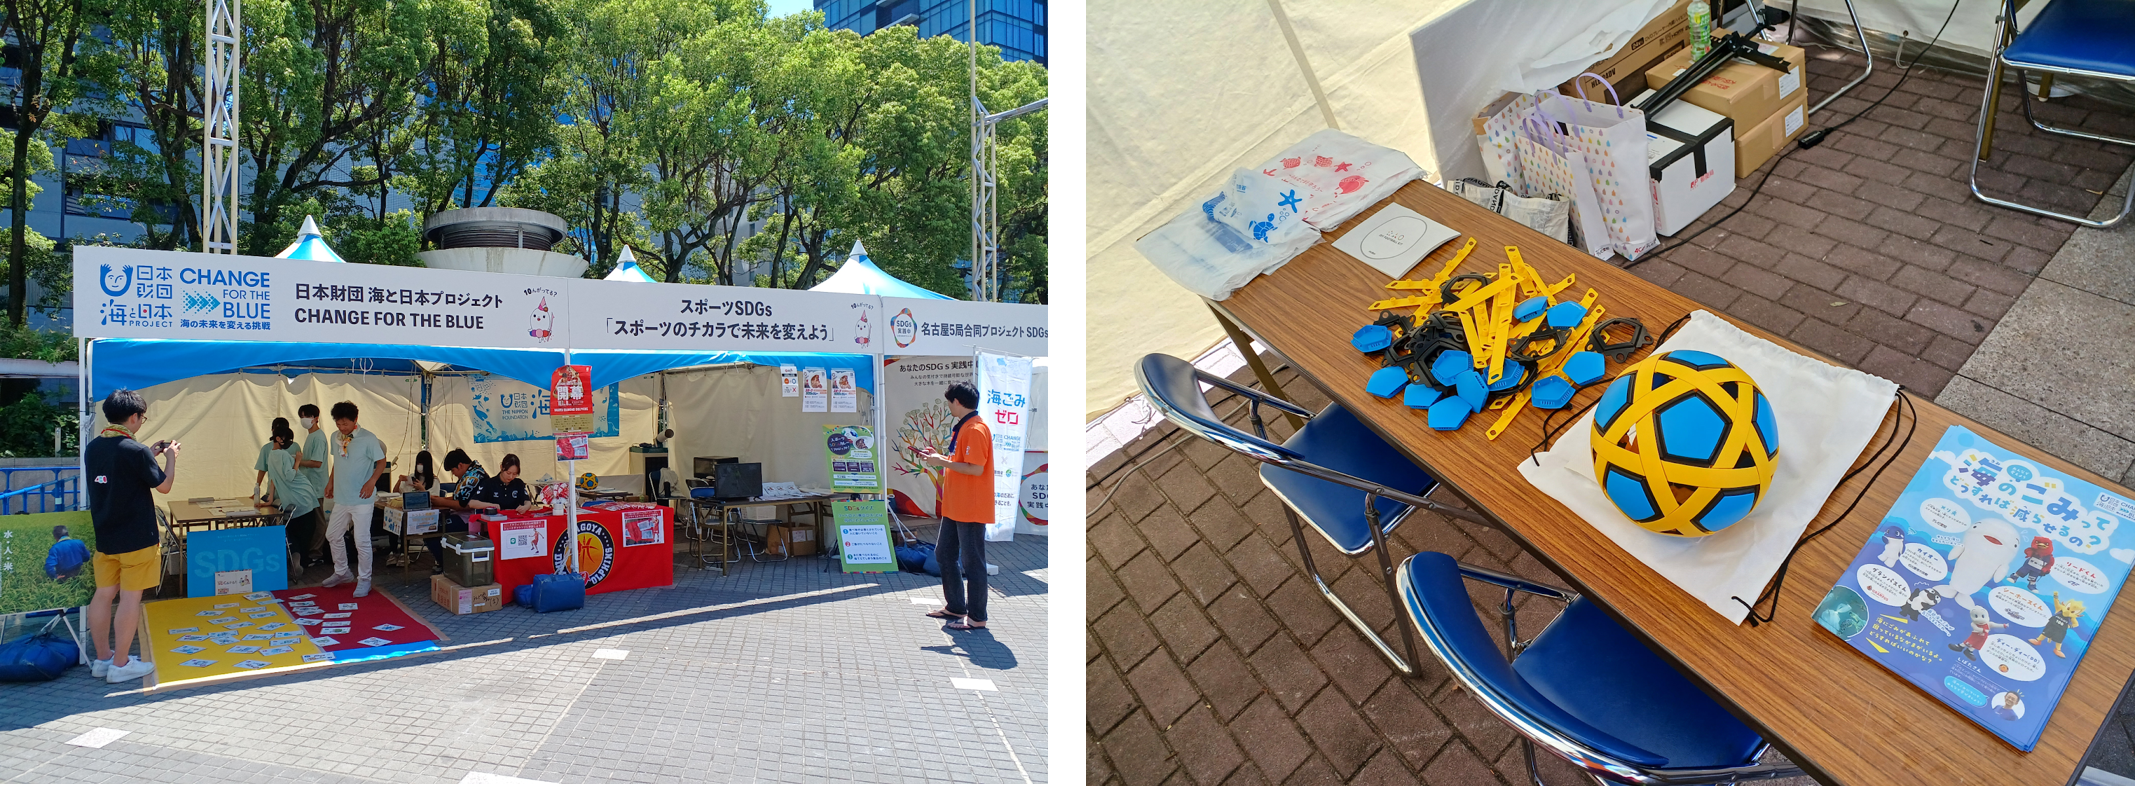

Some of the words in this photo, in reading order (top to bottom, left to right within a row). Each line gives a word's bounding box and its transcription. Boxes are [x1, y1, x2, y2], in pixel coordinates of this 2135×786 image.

[137, 265, 172, 281] 日本
[179, 267, 270, 288] CHANGE
[137, 283, 172, 299] 財団
[223, 289, 247, 300] FOR
[250, 290, 271, 301] THE
[295, 283, 364, 303] 日本財団
[368, 286, 503, 309] 海と日本プロジェクト
[100, 299, 173, 326] 海と日本
[223, 301, 271, 320] BLUE
[680, 298, 773, 317] スポーツSDGs
[129, 320, 173, 328] PROJECT
[180, 318, 271, 331] 海の未来を変える挑戦
[294, 307, 370, 325] CHANGE
[374, 311, 406, 327] FOR
[409, 313, 442, 328] THE
[445, 315, 484, 330] BLUE
[896, 319, 912, 328] SDGs
[606, 317, 835, 342] 「スポーツのチカラで未来を変えよう」
[921, 321, 1025, 339] 名古屋5局合同プロジェクト
[987, 388, 1026, 408] 海ごみ
[995, 409, 1019, 425] ゼロ
[1032, 492, 1048, 500] SD
[1958, 454, 2111, 531] 海のごみって
[3, 530, 13, 571] 水・人・米
[194, 547, 280, 578] SDGs
[590, 546, 613, 585] DOLPHINS
[2066, 561, 2096, 579] リードくん
[1872, 567, 1907, 592] グランパスくん
[2003, 587, 2043, 611] シーホースくん
[1876, 616, 1930, 646] 海にごみがあふれて
[1957, 656, 1982, 674] しばたさん
